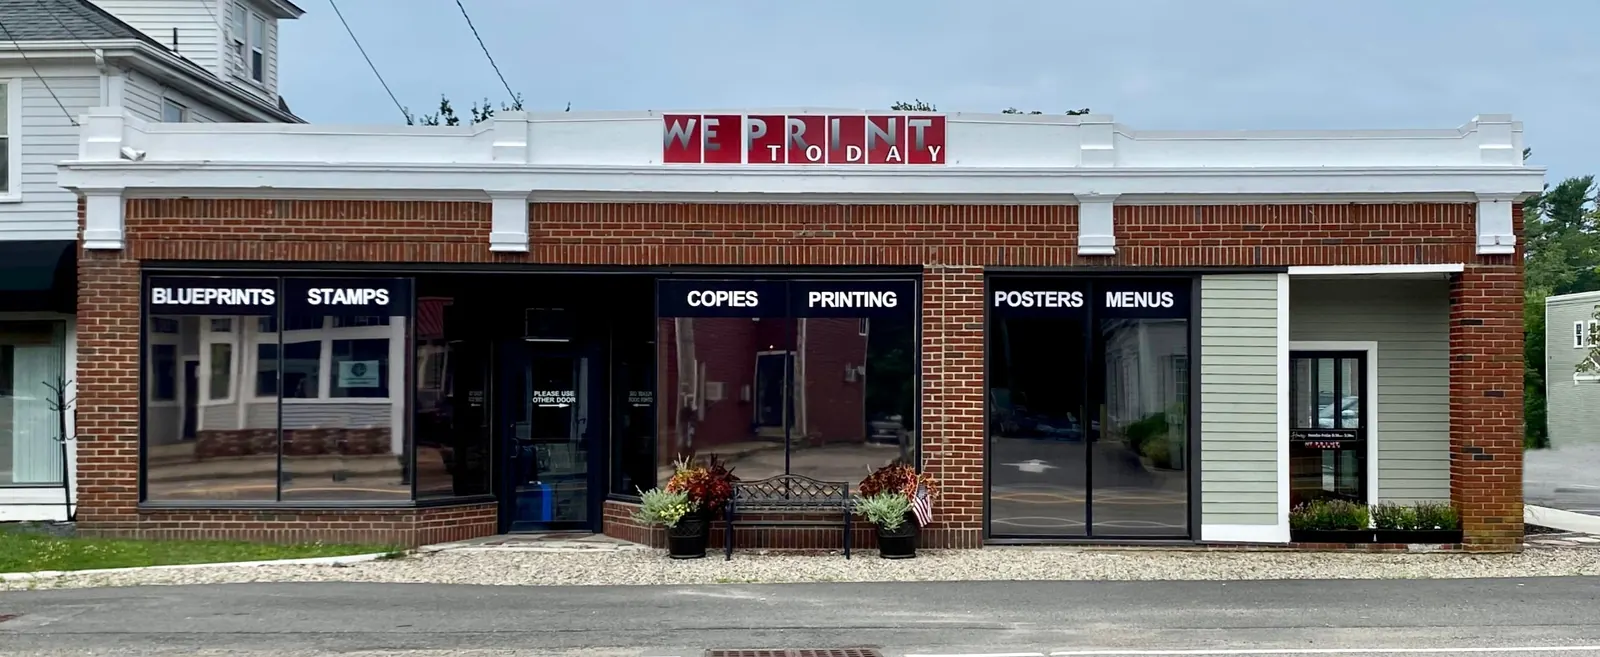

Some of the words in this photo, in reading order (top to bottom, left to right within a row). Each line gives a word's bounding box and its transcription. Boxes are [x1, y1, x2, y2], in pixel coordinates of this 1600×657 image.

[663, 118, 721, 150] WE
[749, 117, 933, 151] PRINT
[766, 145, 942, 162] TODAY
[152, 287, 276, 306] BLUEPRINTS
[307, 287, 389, 306] STAMPS
[687, 290, 759, 307] COPIES
[808, 291, 898, 308] PRINTING
[994, 290, 1084, 308] POSTERS
[1106, 291, 1174, 308] MENUS
